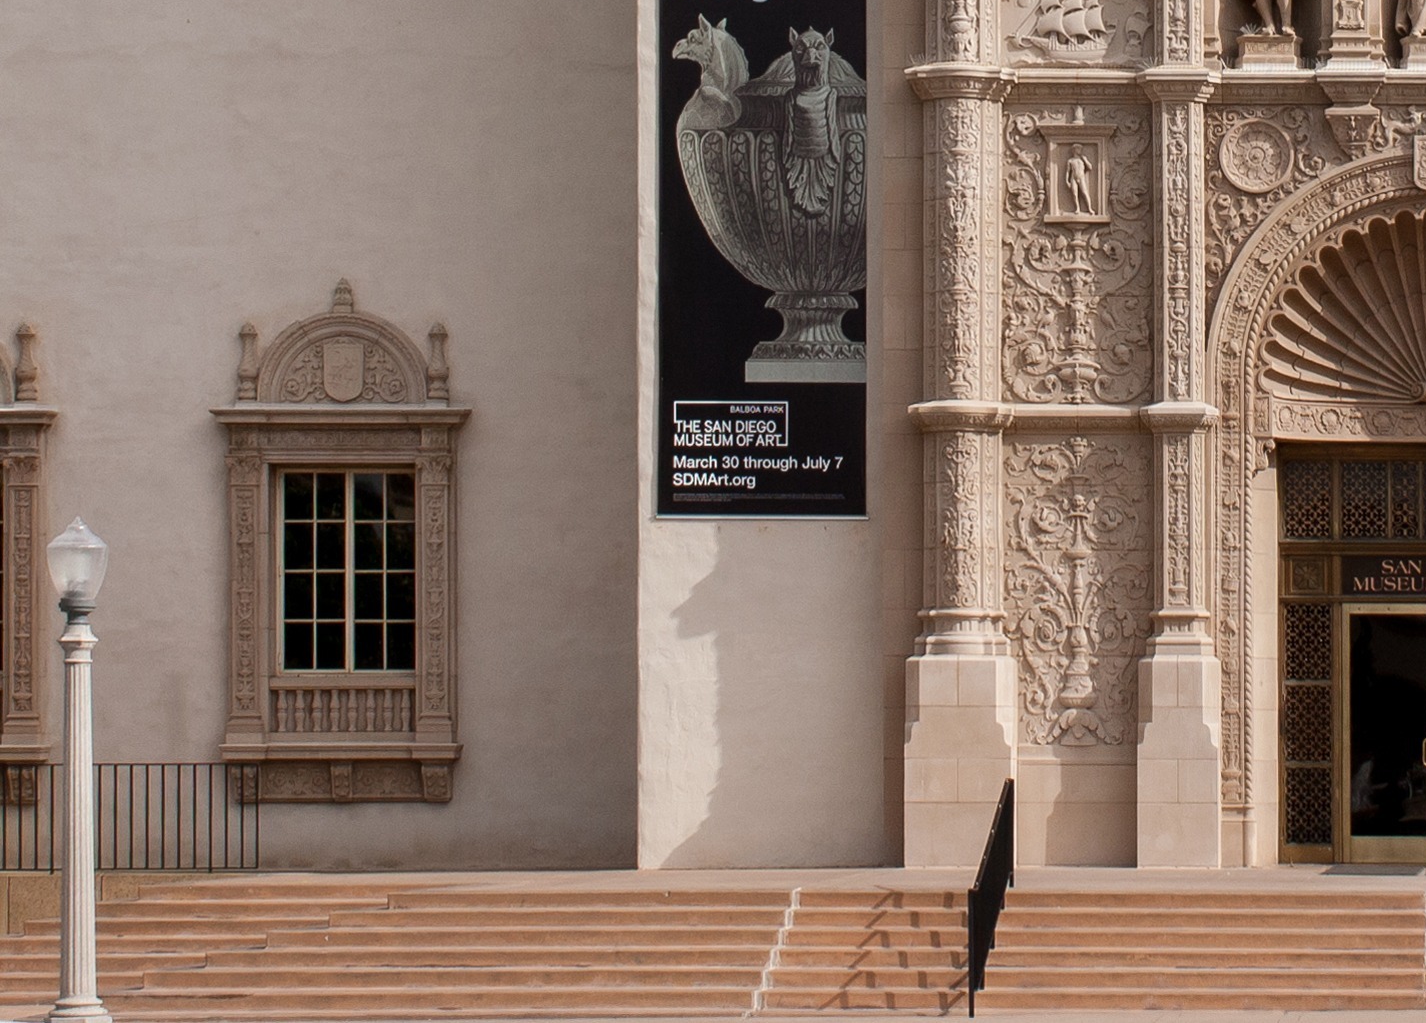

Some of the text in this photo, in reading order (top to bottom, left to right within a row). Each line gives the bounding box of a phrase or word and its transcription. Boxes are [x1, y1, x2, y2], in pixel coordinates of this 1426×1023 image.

[730, 405, 784, 414] BALBOA PARK
[675, 420, 776, 434] THE SAN DIEGO
[673, 434, 783, 447] MUSEUM OF ART
[673, 455, 844, 472] March 30 through July 7
[673, 473, 756, 489] SDMArt.org
[1381, 559, 1422, 575] SAN
